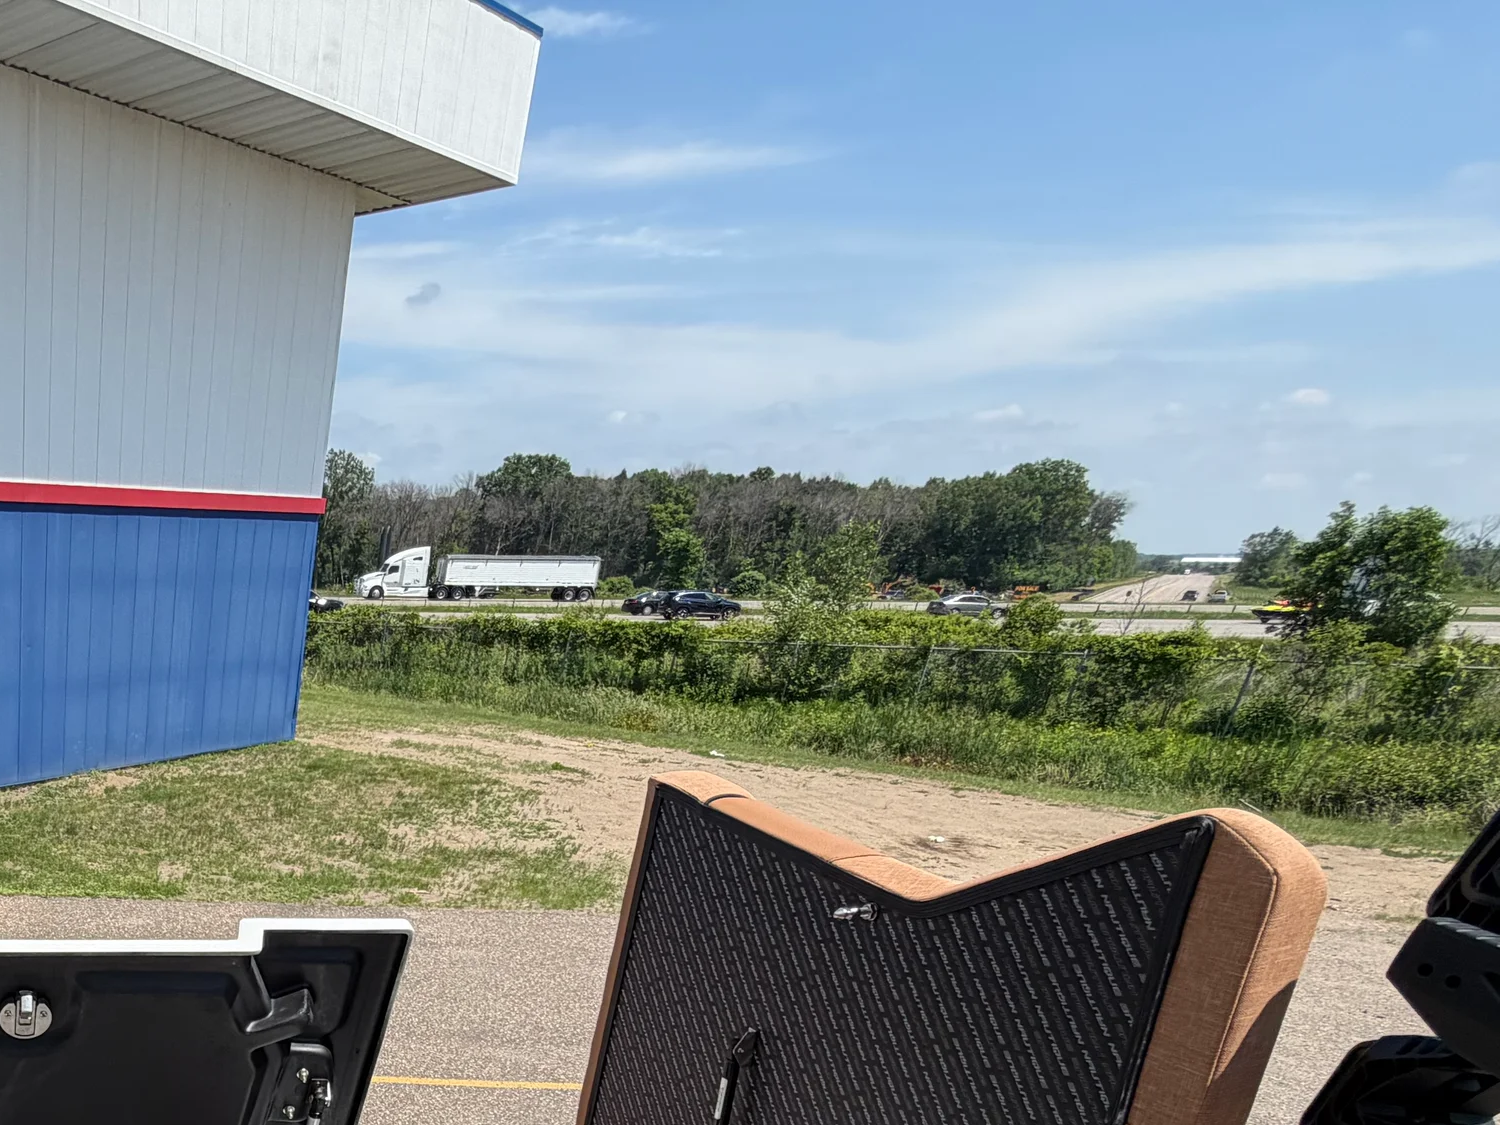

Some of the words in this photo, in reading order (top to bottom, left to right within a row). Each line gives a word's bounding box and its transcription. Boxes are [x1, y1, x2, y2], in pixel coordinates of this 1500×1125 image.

[1016, 898, 1050, 966] NAUTIQUE
[1048, 972, 1084, 1045] NAUTIQUE
[1039, 887, 1075, 958] NAUTIQUE
[1072, 963, 1110, 1037] NAUTIQUE
[1084, 923, 1122, 996] NAUTIQUE
[1101, 894, 1141, 968] NAUTIQUE
[851, 980, 876, 1040] NAUTIQUE
[874, 1043, 900, 1105] NAUTIQUE
[859, 952, 884, 1012] NAUTIQUE
[883, 1017, 909, 1078] NAUTIQUE
[874, 940, 899, 1000] NAUTIQUE
[897, 1004, 925, 1067] NAUTIQUE
[906, 976, 934, 1039] NAUTIQUE
[933, 1044, 962, 1109] NAUTIQUE
[924, 968, 954, 1032] NAUTIQUE
[952, 1037, 982, 1104] NAUTIQUE
[932, 935, 963, 998] NAUTIQUE
[960, 1001, 990, 1068] NAUTIQUE
[973, 977, 1005, 1044] NAUTIQUE
[1003, 1050, 1036, 1120] NAUTIQUE
[985, 946, 1017, 1013] NAUTIQUE
[1015, 1018, 1048, 1088] NAUTIQUE
[1004, 931, 1037, 999] NAUTIQUE
[1035, 1004, 1069, 1076] NAUTIQUE
